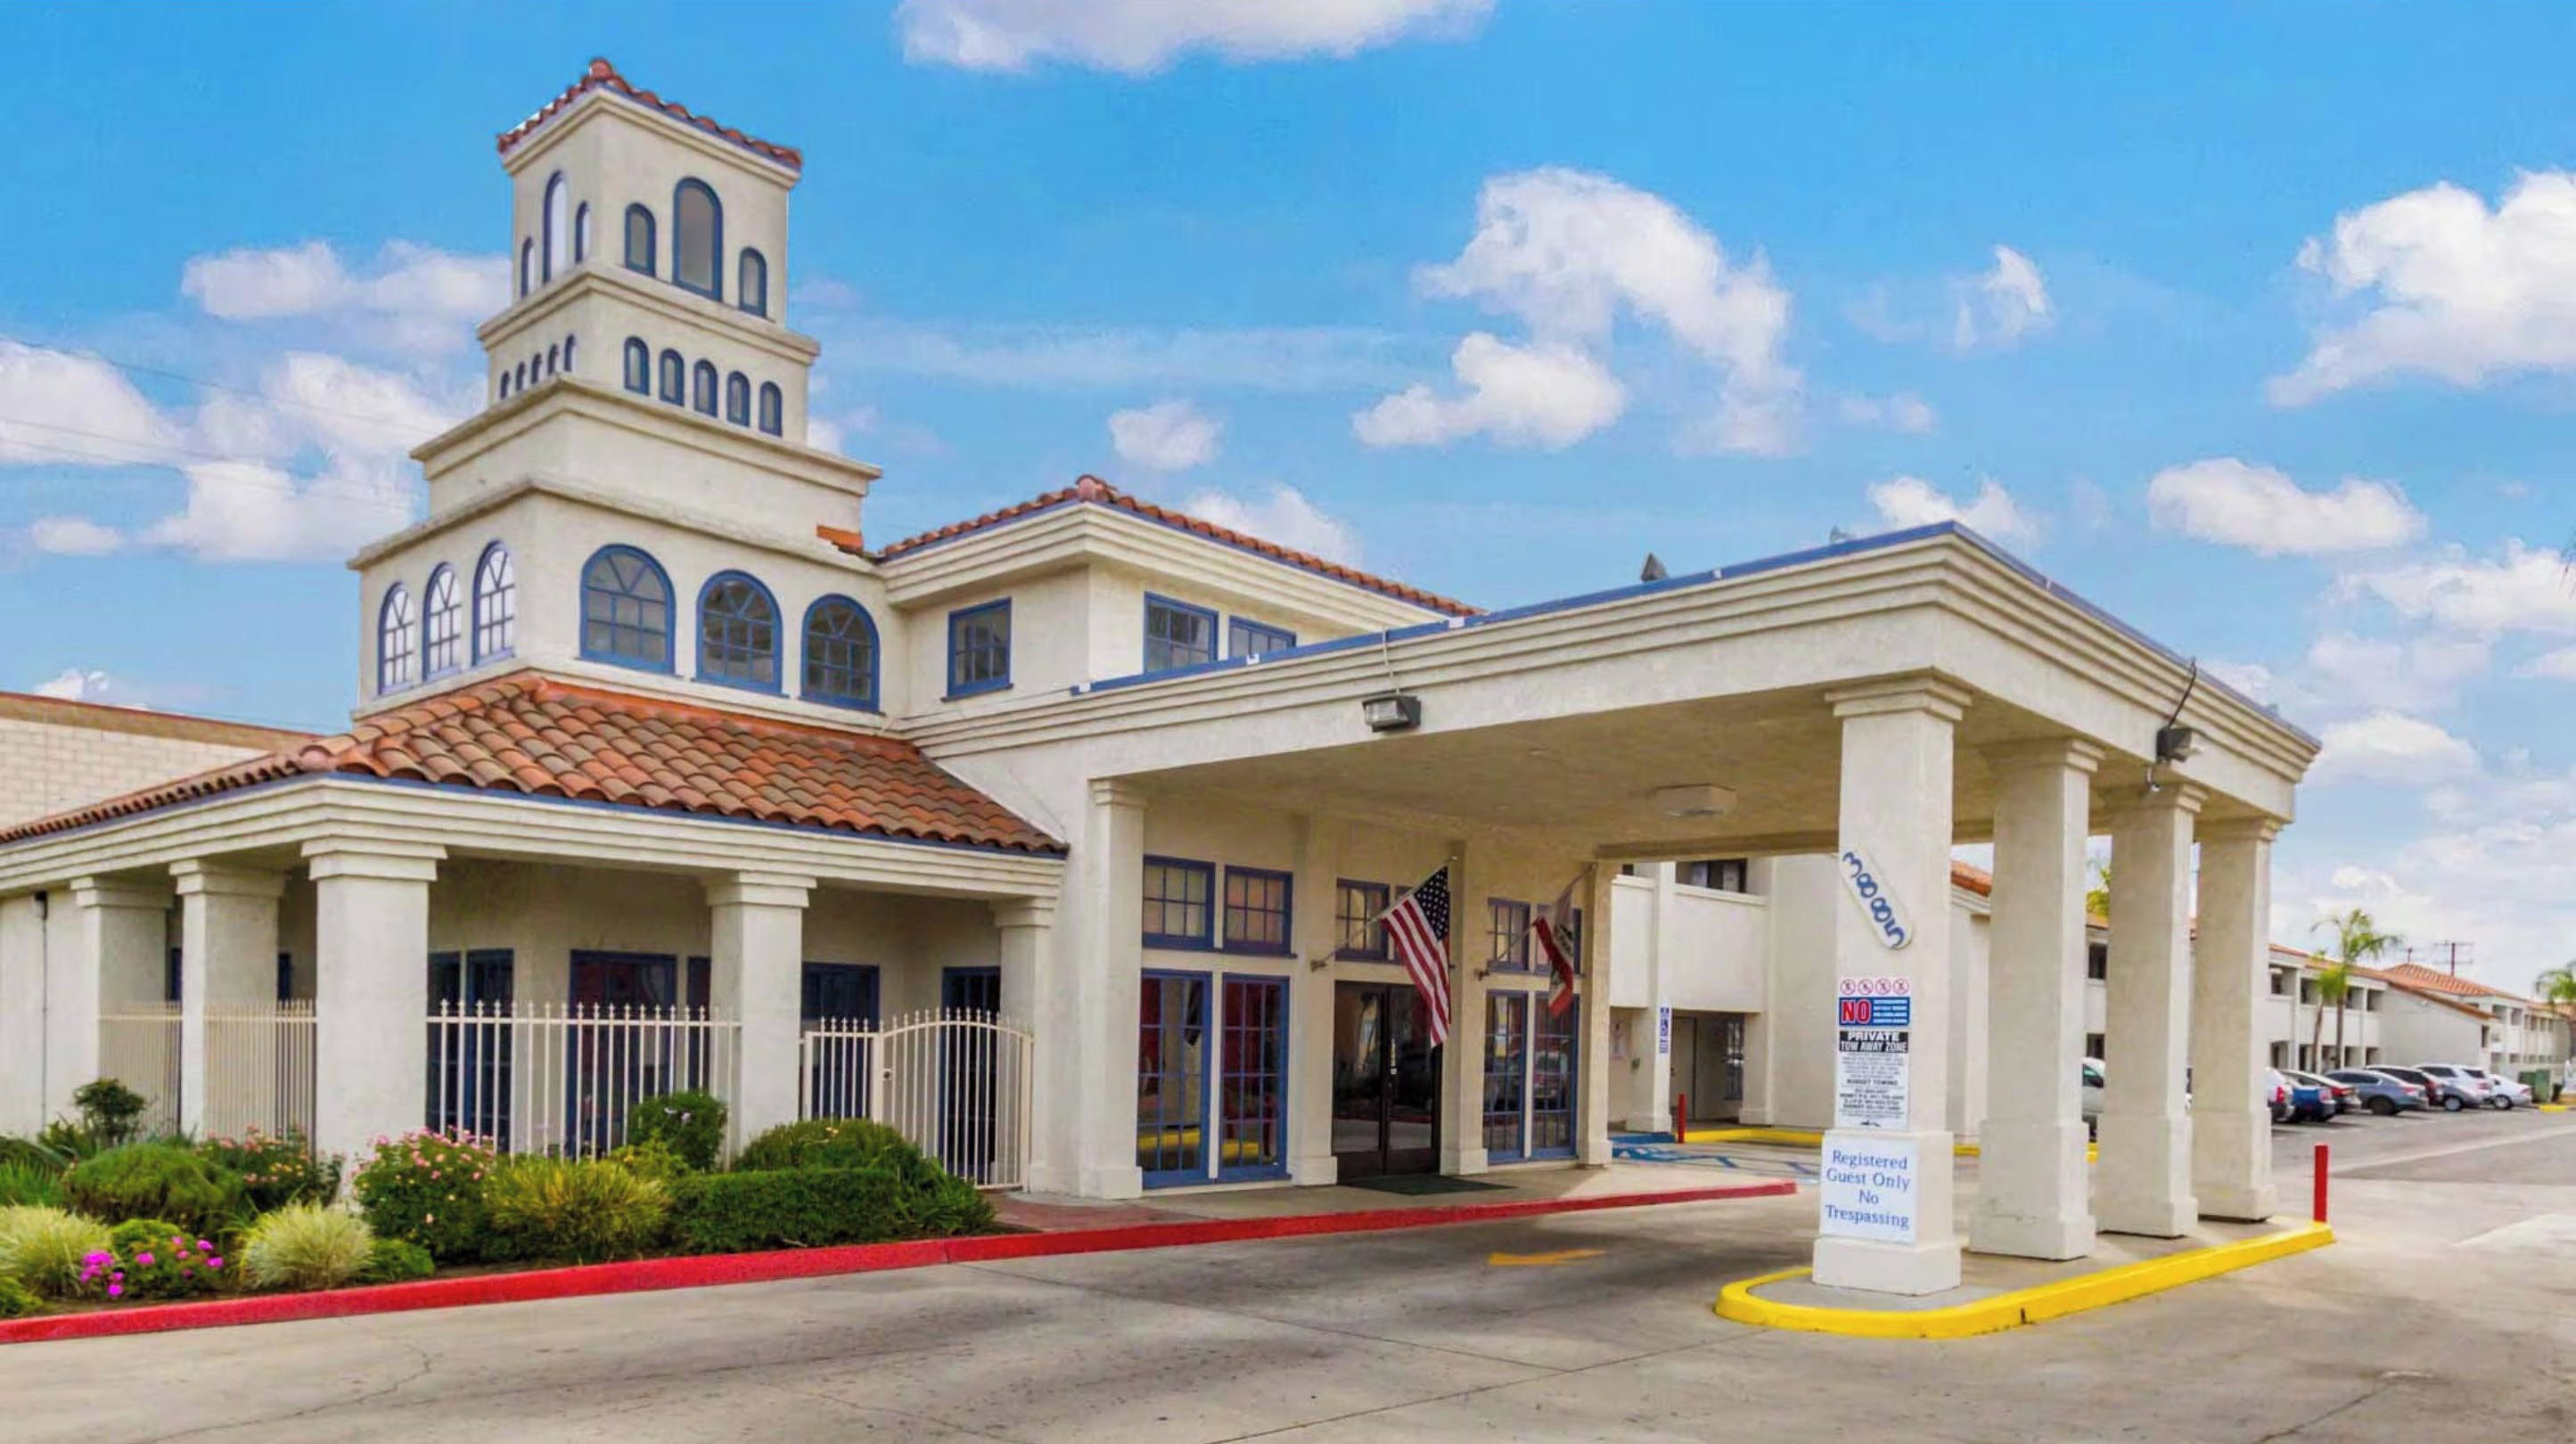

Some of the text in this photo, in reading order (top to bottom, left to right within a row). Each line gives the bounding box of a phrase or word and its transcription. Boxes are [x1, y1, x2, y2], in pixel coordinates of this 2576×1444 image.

[1842, 852, 1905, 948] 3885
[1841, 999, 1872, 1024] NO
[1847, 1030, 1899, 1041] PRIVATE
[1840, 1041, 1907, 1053] TOW AWAY ZONE
[1833, 1150, 1907, 1169] Registered
[1826, 1168, 1911, 1193] Guest Only
[1858, 1189, 1879, 1204] No
[1825, 1204, 1909, 1230] Trespassing
